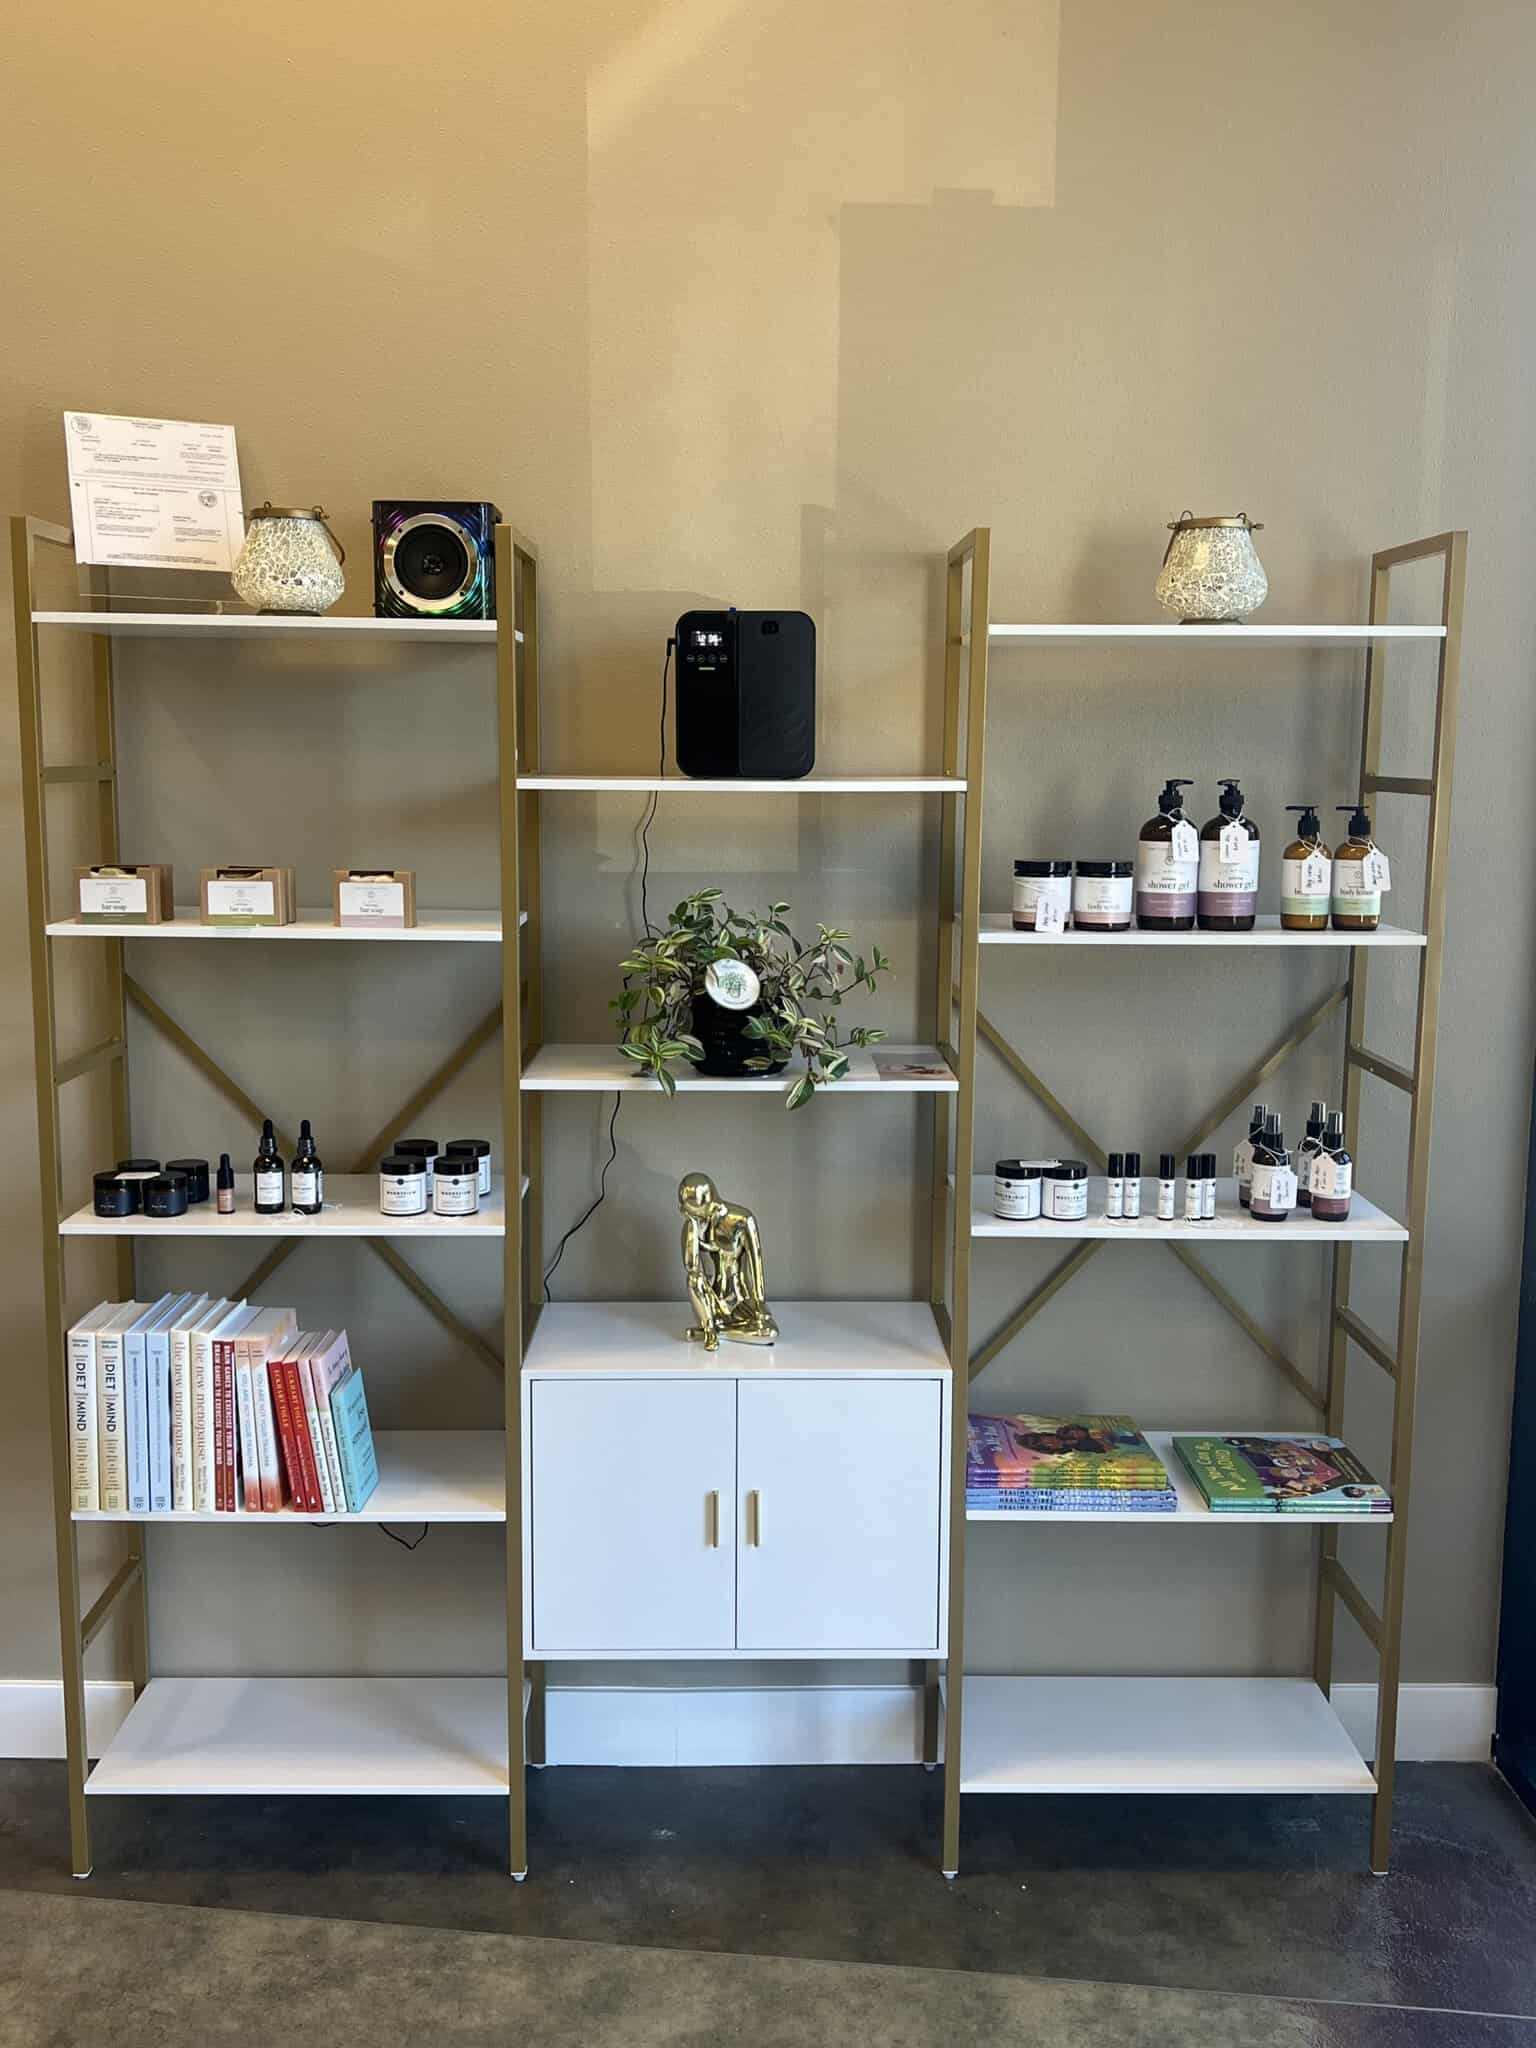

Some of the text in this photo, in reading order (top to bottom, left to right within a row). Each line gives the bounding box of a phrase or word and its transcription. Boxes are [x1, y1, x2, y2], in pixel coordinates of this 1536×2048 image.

[1147, 879, 1176, 889] shower
[1212, 879, 1243, 889] shower
[175, 1342, 186, 1360] the
[195, 1344, 208, 1363] the
[76, 1363, 86, 1389] DIET
[105, 1364, 116, 1391] DIET
[175, 1363, 184, 1388] new
[196, 1365, 204, 1390] new
[76, 1400, 87, 1432] MIND
[105, 1402, 117, 1432] MIND
[173, 1391, 184, 1458] menopause
[194, 1393, 205, 1460] menopause
